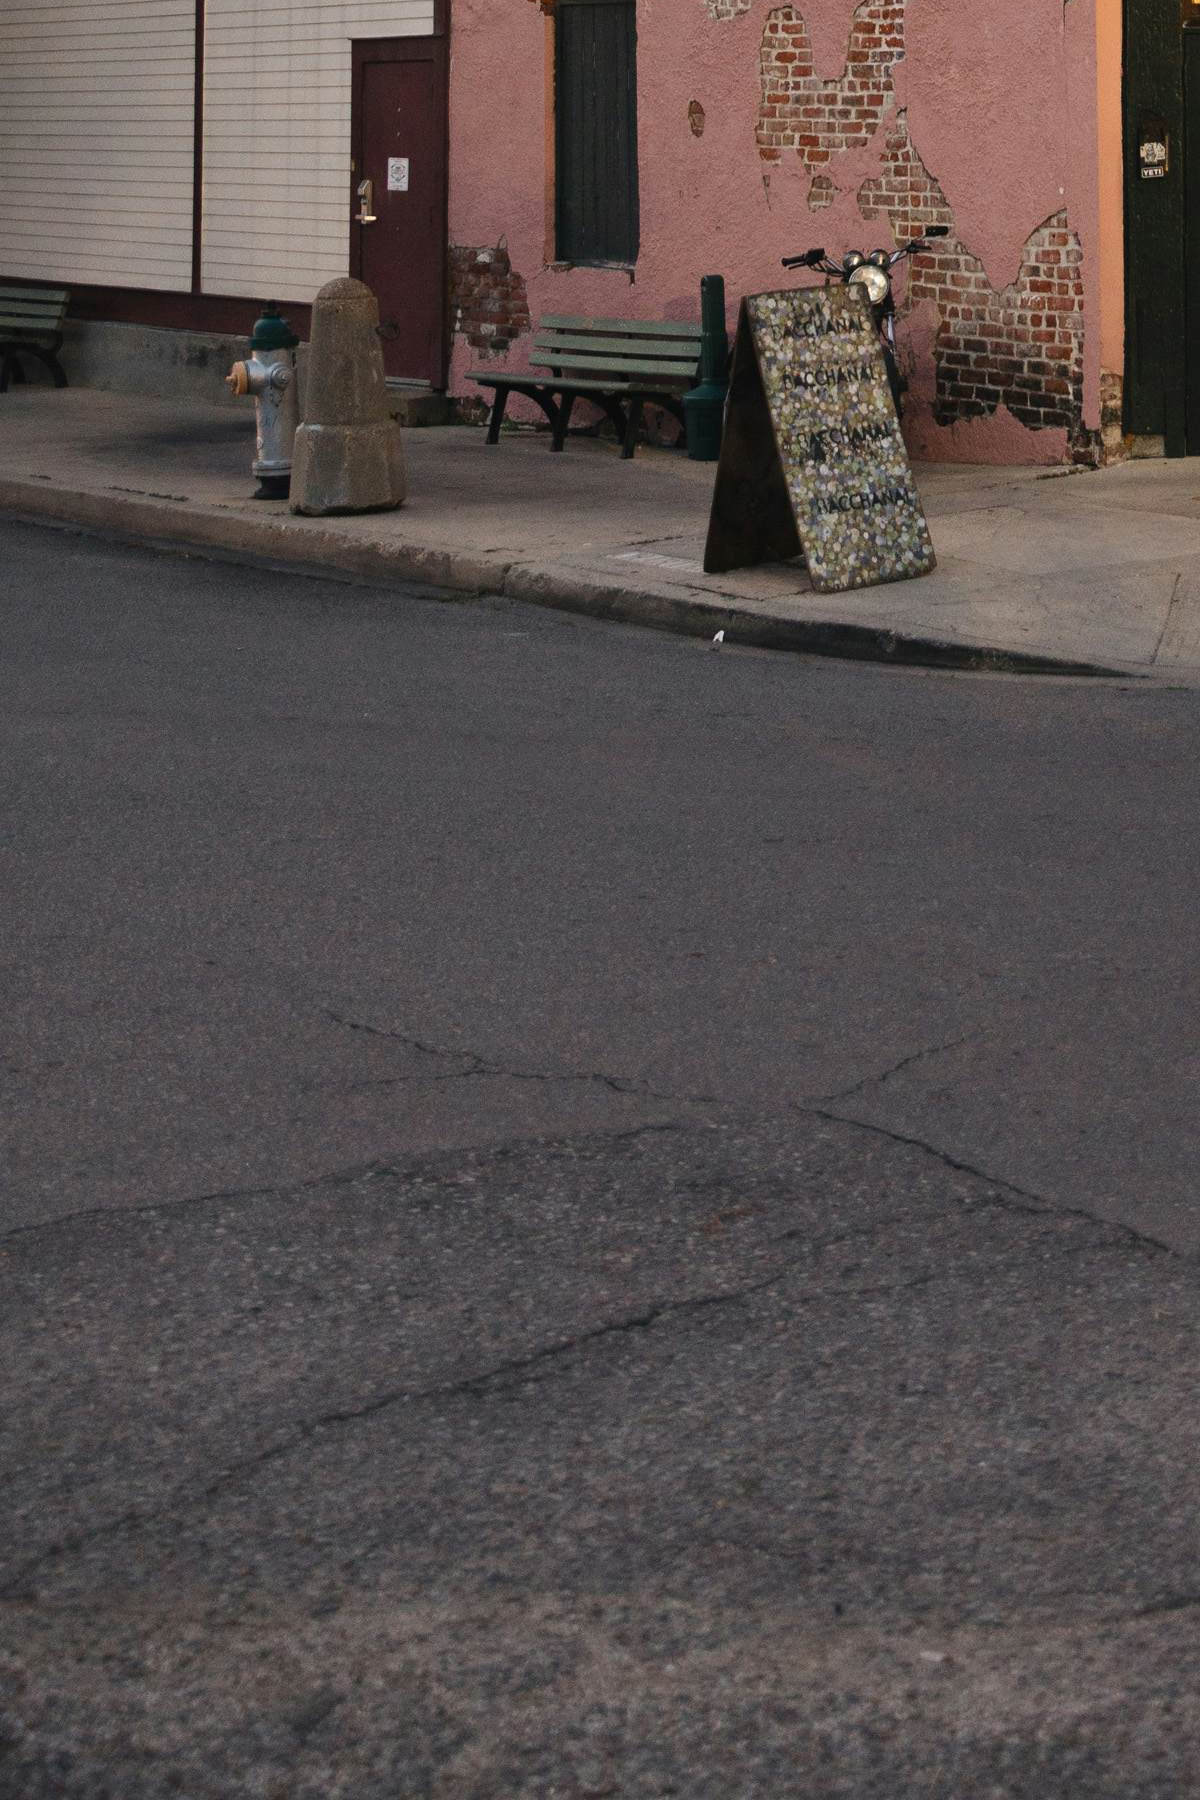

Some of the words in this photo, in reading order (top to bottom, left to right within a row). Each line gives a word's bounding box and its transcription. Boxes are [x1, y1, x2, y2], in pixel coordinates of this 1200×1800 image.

[772, 315, 865, 339] BACCHANAL
[783, 364, 879, 389] BACCHANAL
[797, 421, 892, 449] BACCHANAL
[816, 488, 914, 514] BACCHANAL
